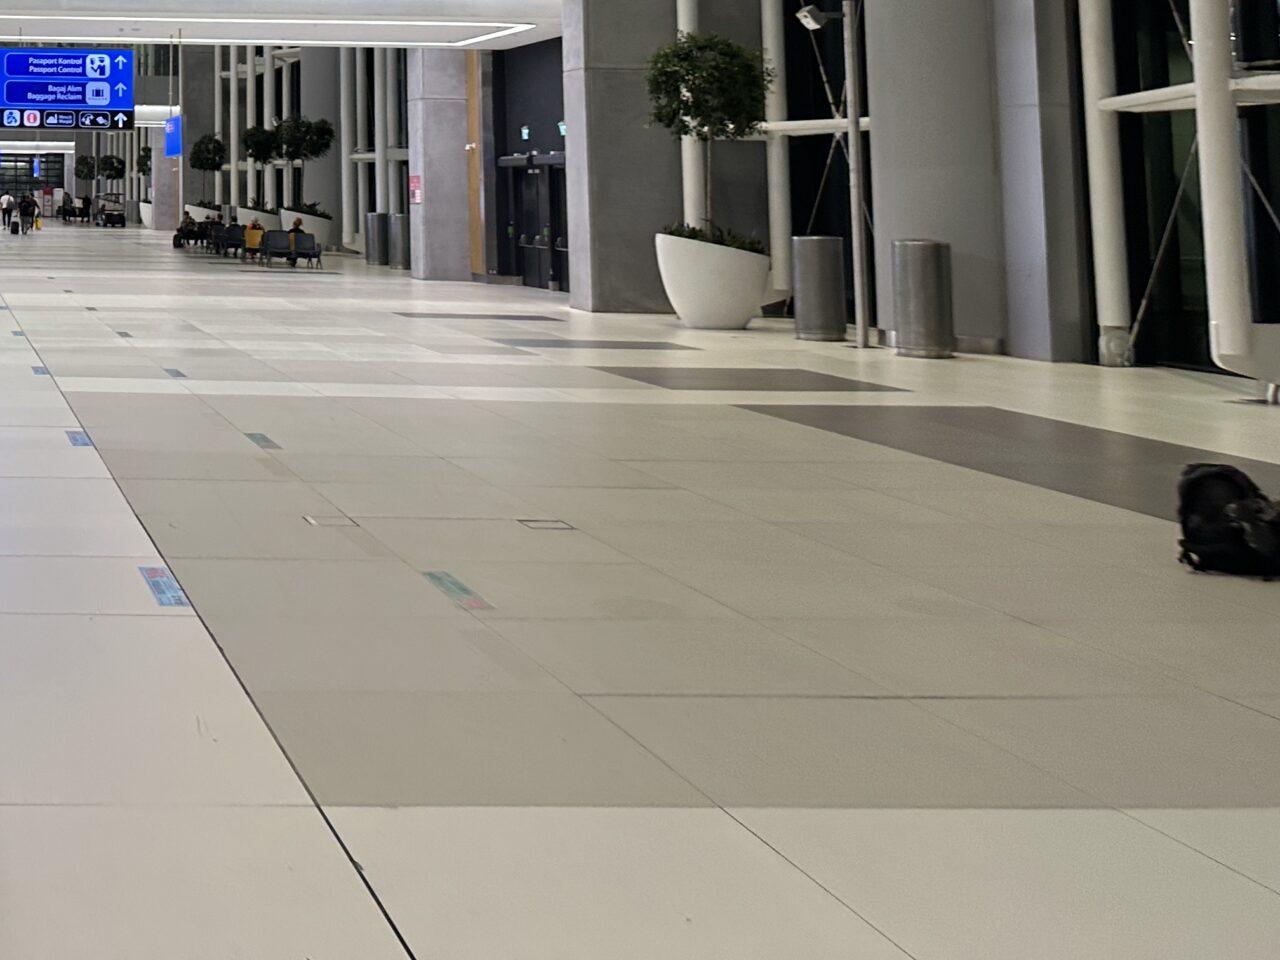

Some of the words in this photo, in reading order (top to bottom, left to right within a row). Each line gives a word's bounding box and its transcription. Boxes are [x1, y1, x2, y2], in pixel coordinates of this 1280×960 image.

[28, 57, 57, 66] Pasaport
[58, 57, 82, 65] Kontrol
[28, 65, 57, 74] Passport
[57, 65, 82, 73] Control
[47, 84, 66, 93] Bagaj
[27, 92, 57, 101] Baggage
[57, 92, 82, 100] Reclaim
